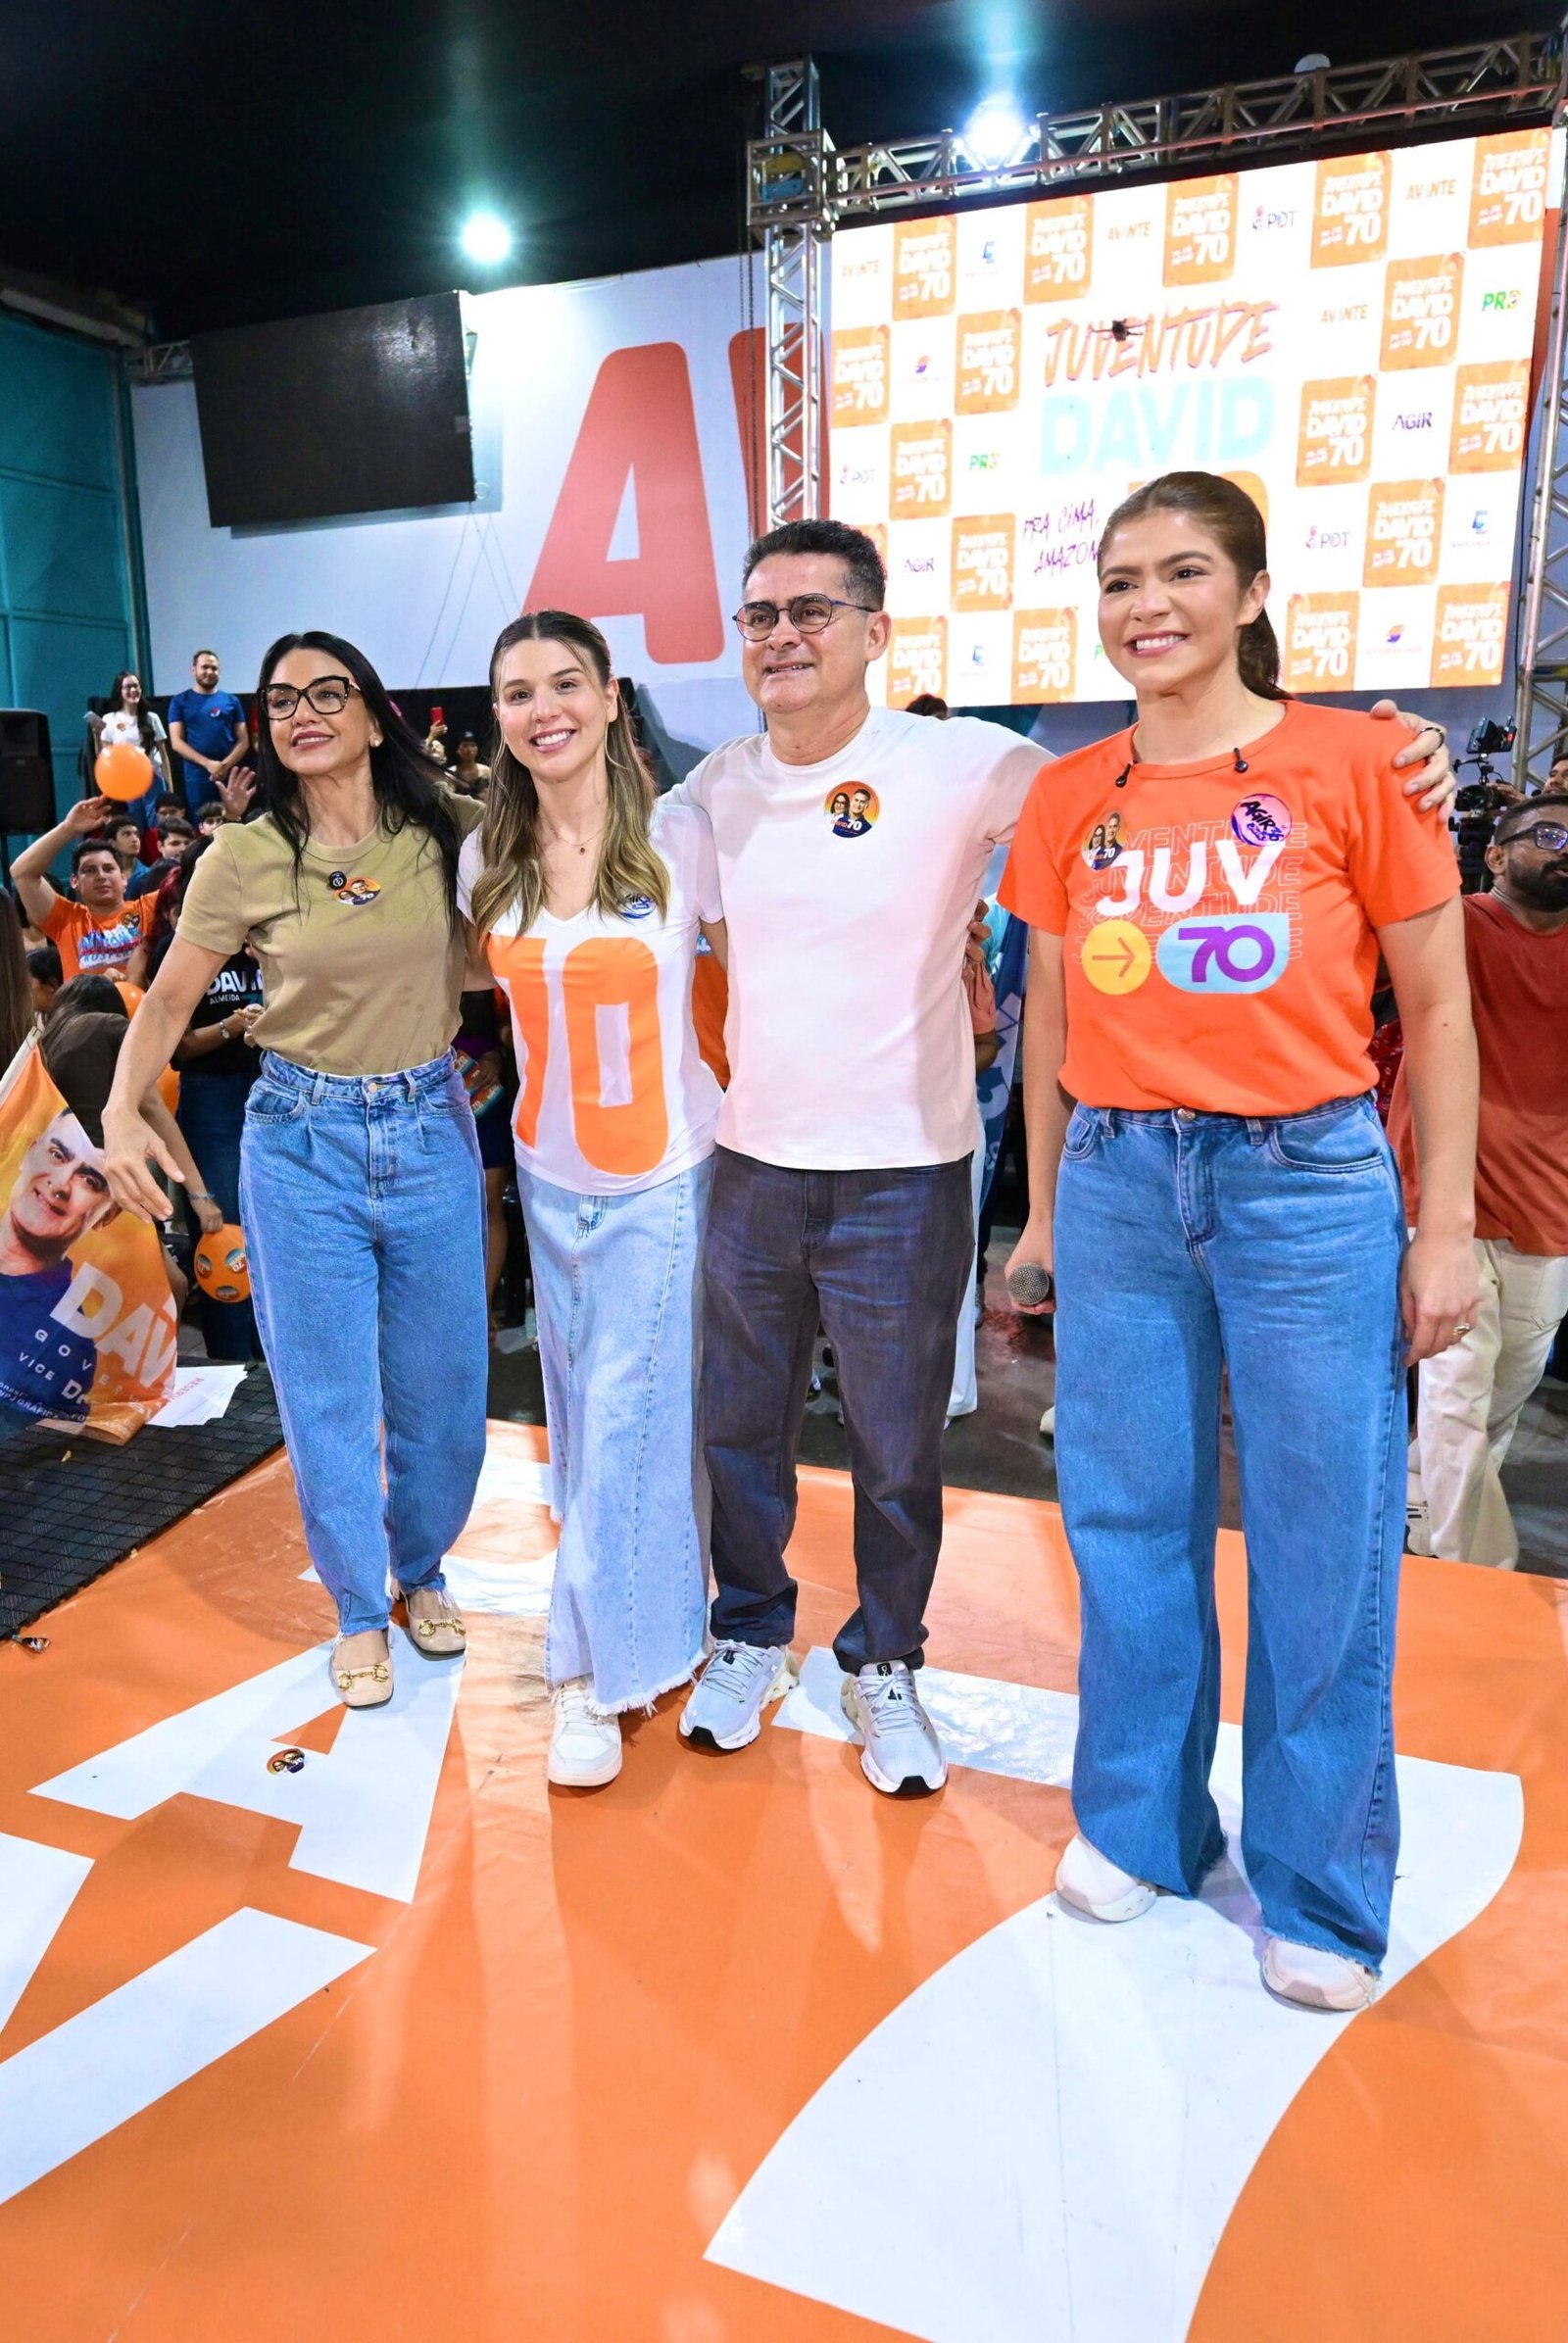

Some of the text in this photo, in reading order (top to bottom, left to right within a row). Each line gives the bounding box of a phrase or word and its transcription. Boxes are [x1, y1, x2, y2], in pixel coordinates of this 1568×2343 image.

[1480, 166, 1545, 196] DAVID
[1321, 188, 1383, 217] DAVID
[1503, 189, 1544, 225] 70
[1172, 210, 1230, 236] DAVID
[1344, 212, 1381, 246] 70
[1032, 230, 1087, 257] DAVID
[1194, 232, 1229, 265] 70
[899, 249, 951, 273] DAVID
[1052, 252, 1086, 283] 70
[918, 269, 951, 301] 70
[1391, 293, 1453, 320] DAVID
[1045, 299, 1279, 387] JUVENTUDE
[1413, 316, 1451, 349] 70
[834, 360, 885, 384] DAVID
[961, 345, 1014, 369] DAVID
[853, 380, 884, 410] 70
[981, 366, 1013, 396] 70
[1041, 375, 1276, 476] DAVID
[1306, 413, 1366, 439] DAVID
[1460, 399, 1524, 424] DAVID
[1329, 436, 1364, 466] 70
[1483, 421, 1522, 454] 70
[895, 453, 947, 476] DAVID
[914, 473, 946, 502] 70
[1373, 515, 1435, 540] DAVID
[956, 547, 1008, 570] DAVID
[1396, 538, 1432, 568] 70
[975, 566, 1007, 596] 70
[1292, 626, 1350, 649] DAVID
[1442, 618, 1502, 642] DAVID
[893, 647, 942, 670] DAVID
[1018, 641, 1070, 663] DAVID
[1313, 647, 1348, 677] 70
[1463, 639, 1500, 671] 70
[910, 665, 941, 696] 70
[1038, 660, 1069, 690] 70
[847, 819, 862, 831] 70
[1103, 847, 1115, 858] 70
[1096, 839, 1284, 916] JUV
[1178, 925, 1274, 983] 70
[210, 994, 240, 1004] ALMEIDA
[19, 1351, 56, 1381] VICE
